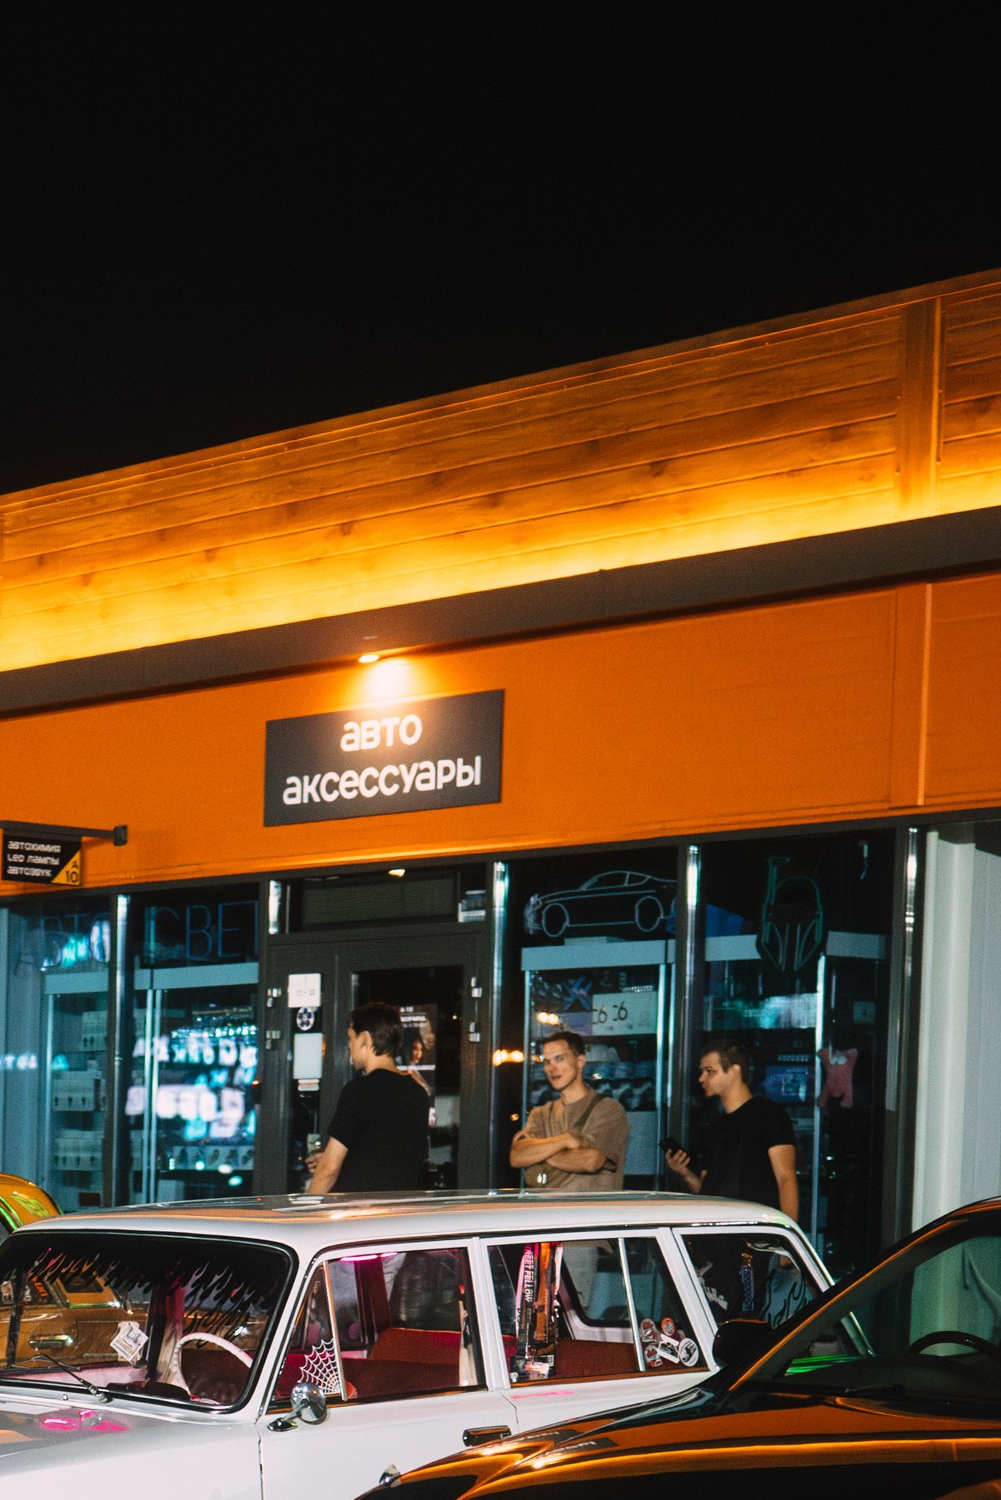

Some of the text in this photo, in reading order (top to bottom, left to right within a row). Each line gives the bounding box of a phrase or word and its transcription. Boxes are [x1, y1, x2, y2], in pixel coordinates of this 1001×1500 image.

[340, 714, 422, 751] авто
[283, 756, 481, 805] аксессуары
[65, 870, 78, 883] 10
